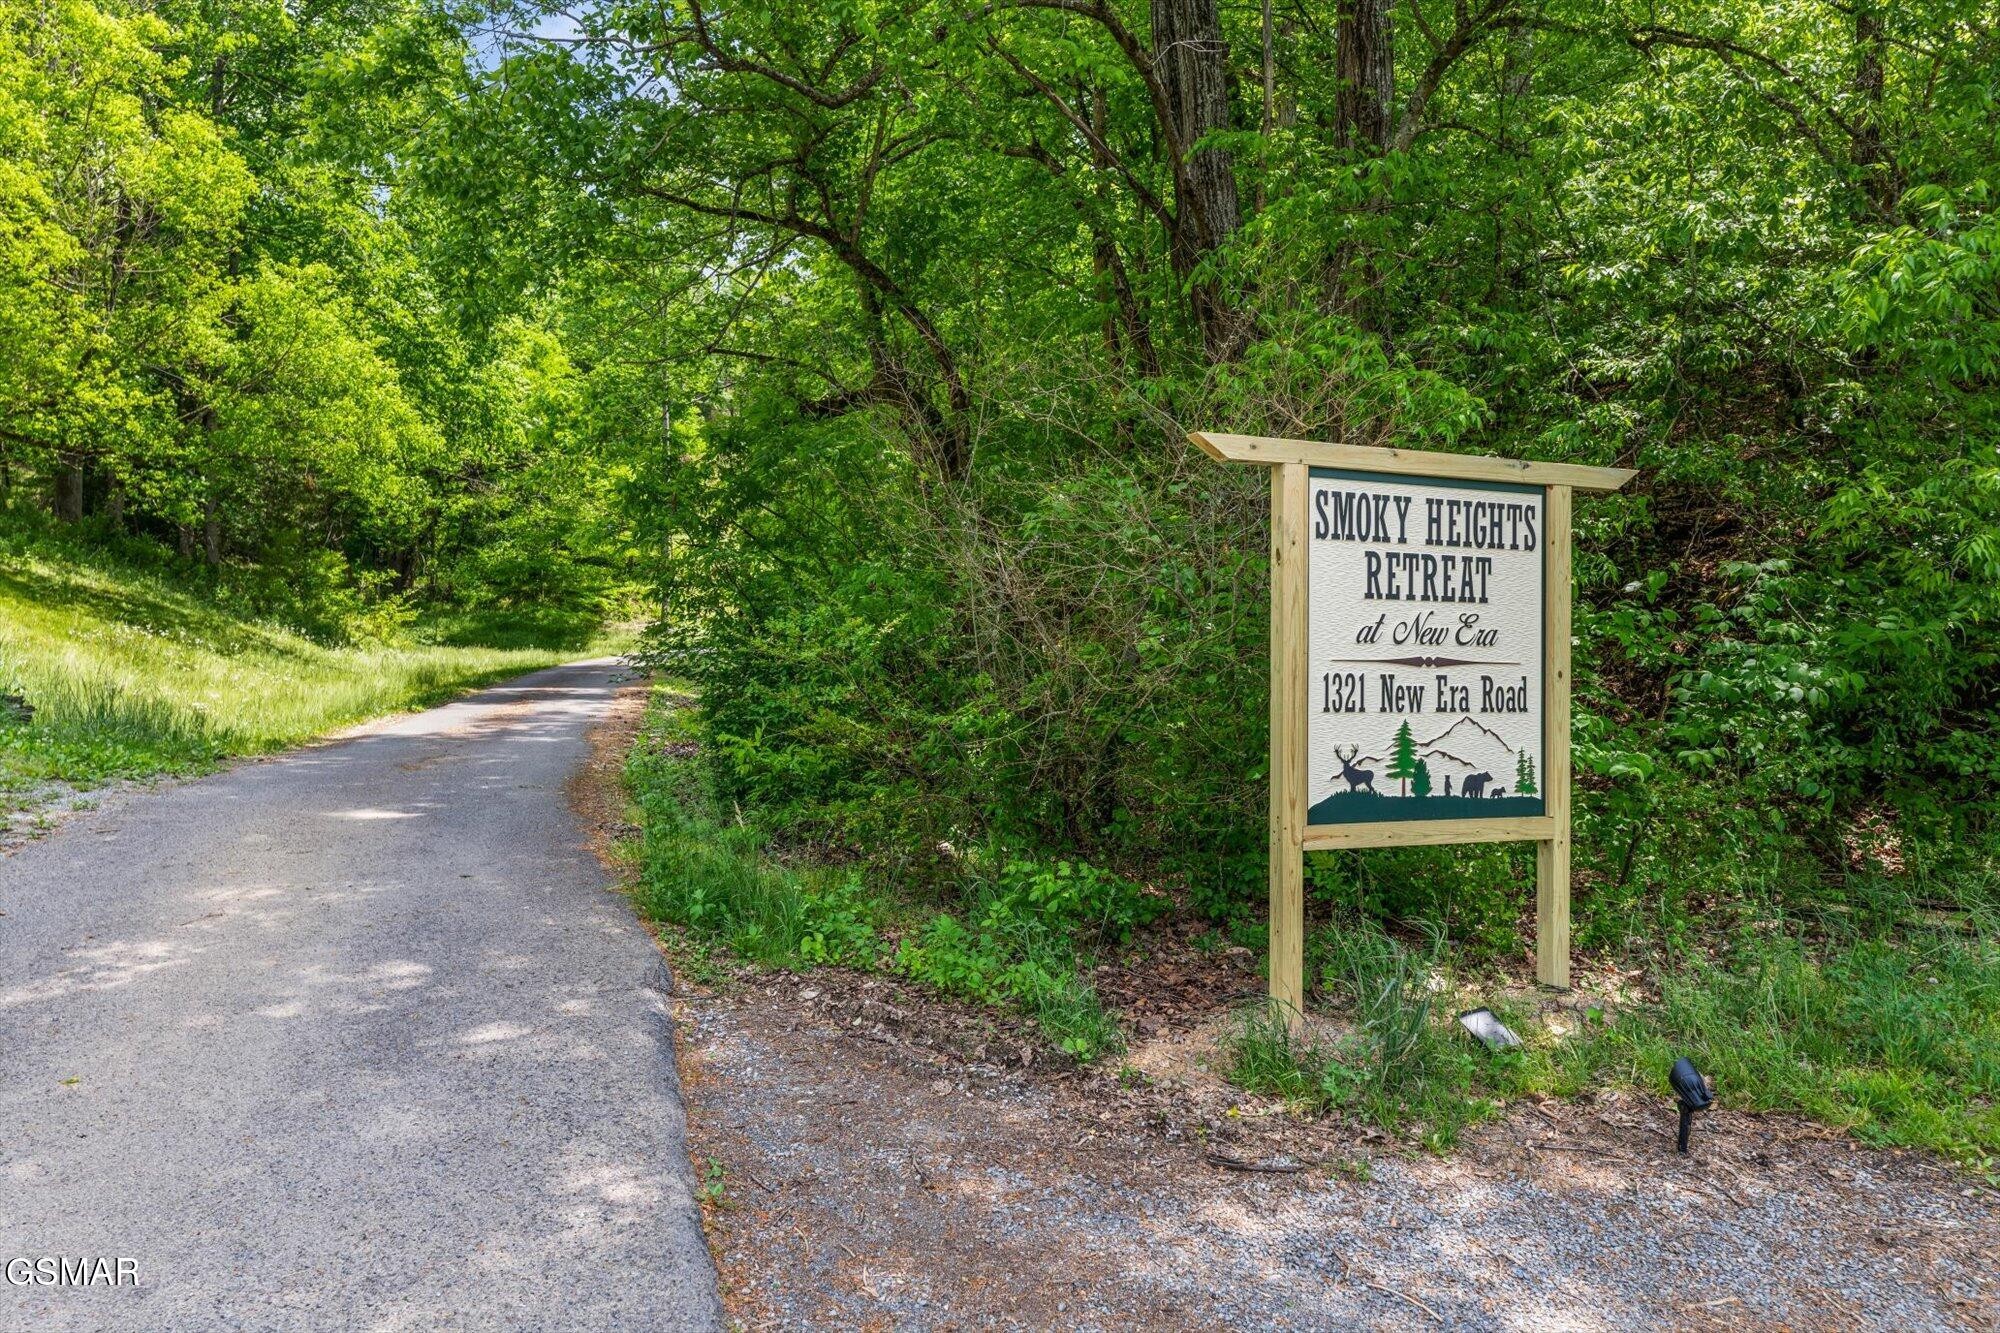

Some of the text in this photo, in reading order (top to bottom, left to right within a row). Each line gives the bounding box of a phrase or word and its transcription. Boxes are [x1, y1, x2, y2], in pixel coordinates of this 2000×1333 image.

[1315, 489, 1537, 551] SMOKY HEIGHTS
[1364, 550, 1492, 603] RETREAT
[1356, 610, 1499, 647] at New Era
[1323, 672, 1528, 713] 1321 New Era Road
